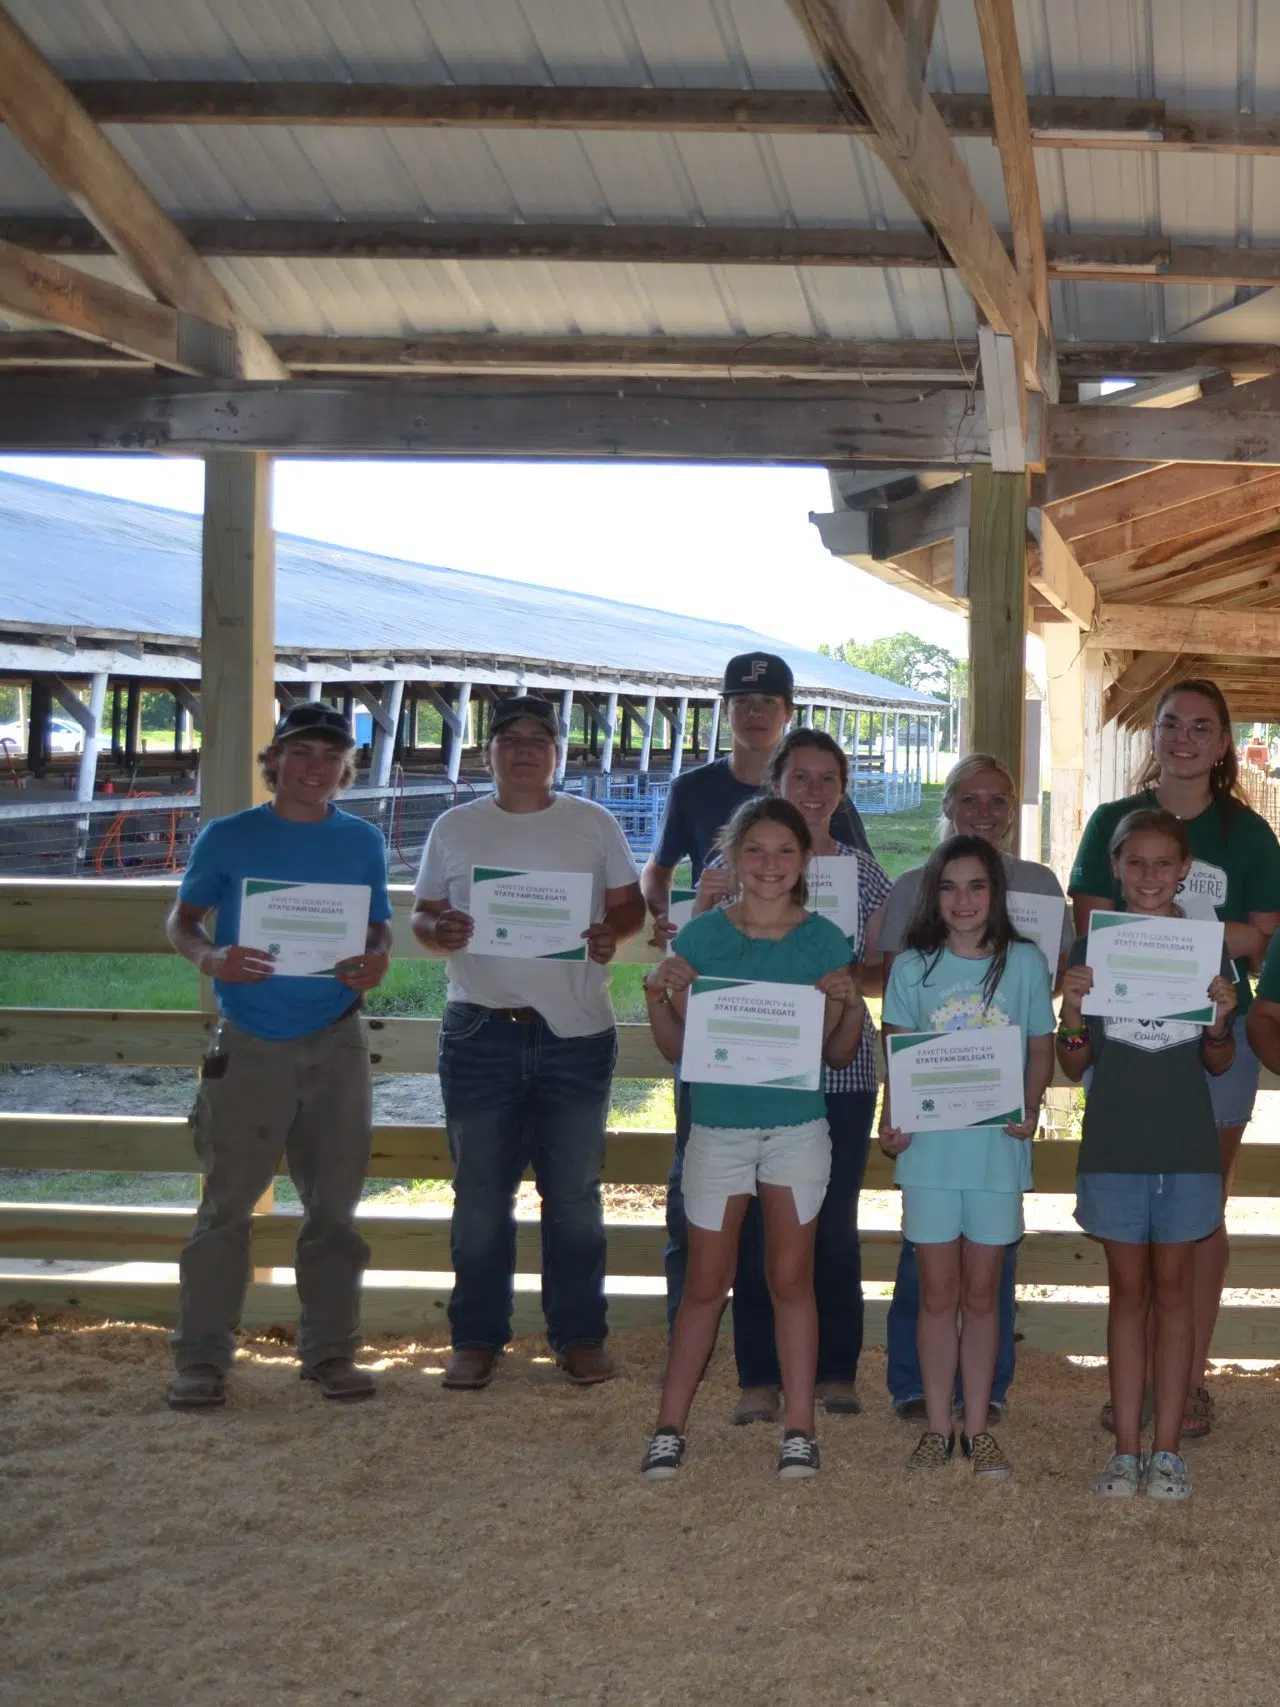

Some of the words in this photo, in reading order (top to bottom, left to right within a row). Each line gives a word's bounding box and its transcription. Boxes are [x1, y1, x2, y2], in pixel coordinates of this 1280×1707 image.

[1193, 872, 1217, 880] LOCAL
[1189, 879, 1223, 899] HERE
[1012, 915, 1038, 924] LEGATE
[1118, 932, 1148, 940] FAYETTE
[1149, 934, 1179, 942] COUNTY
[1156, 942, 1195, 952] DELEGATE
[718, 996, 749, 1004] FAYETTE
[714, 1004, 738, 1012] STATE
[757, 1007, 796, 1017] DELEGATE
[1134, 1031, 1171, 1044] County
[918, 1048, 948, 1056] FAYETTE
[950, 1046, 978, 1054] COUNTY
[956, 1054, 995, 1062] DELEGATE
